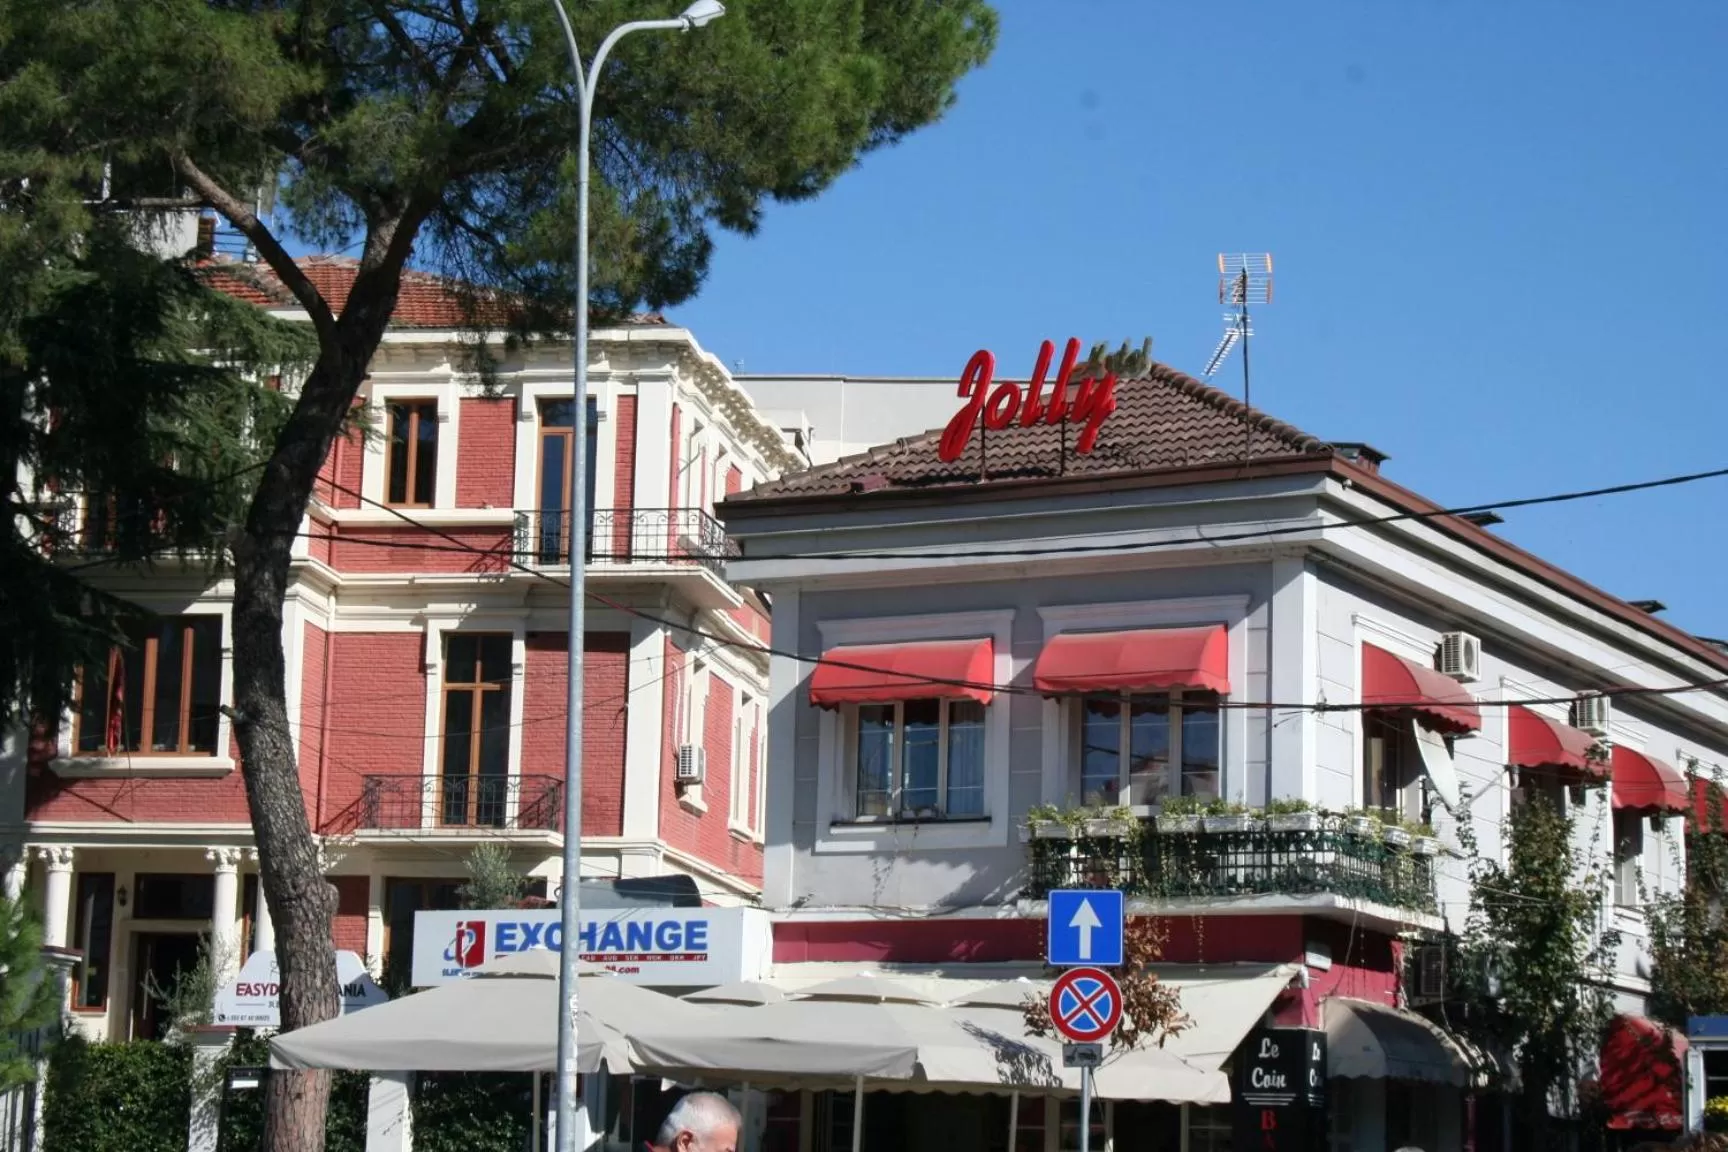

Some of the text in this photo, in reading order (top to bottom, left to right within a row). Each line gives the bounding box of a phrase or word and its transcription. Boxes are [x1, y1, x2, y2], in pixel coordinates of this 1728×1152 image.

[938, 337, 1117, 463] Jolly
[495, 920, 708, 952] EXCHANGE
[236, 983, 280, 997] EASYD
[1258, 1037, 1280, 1058] Le
[1251, 1067, 1287, 1088] Coin
